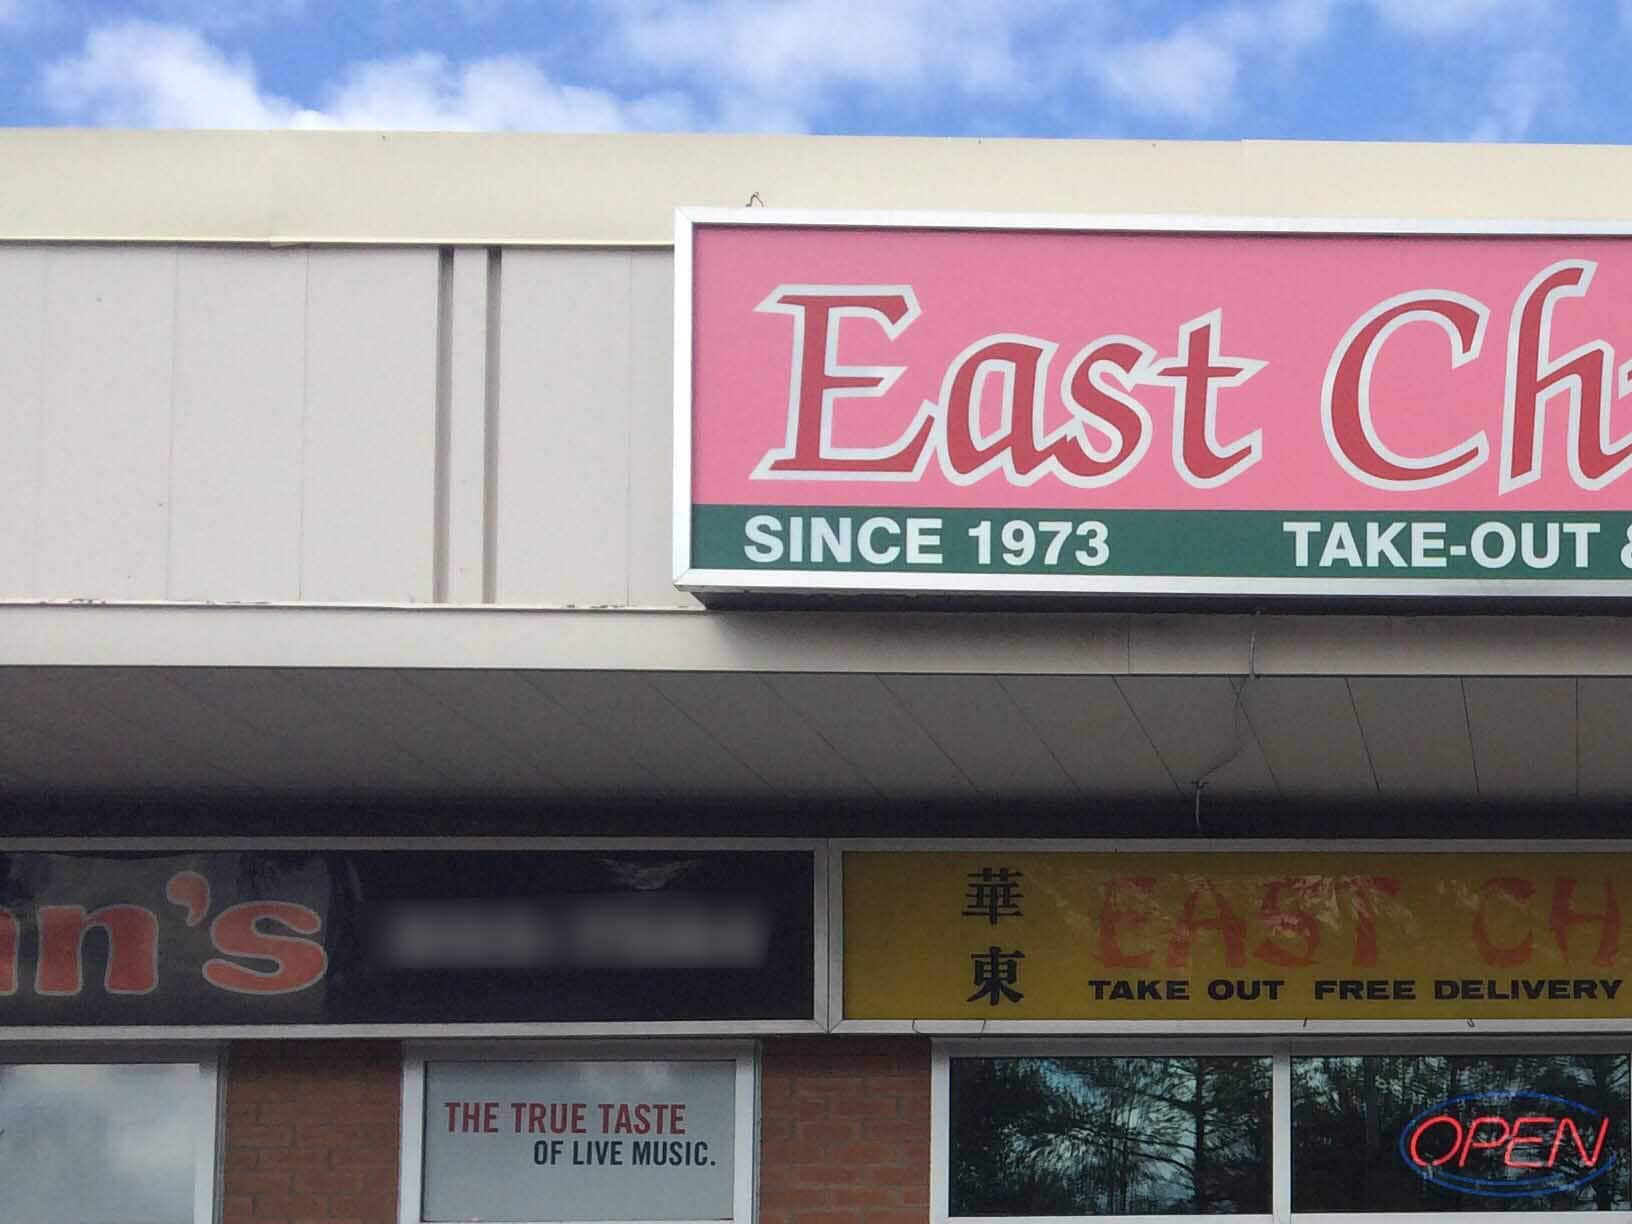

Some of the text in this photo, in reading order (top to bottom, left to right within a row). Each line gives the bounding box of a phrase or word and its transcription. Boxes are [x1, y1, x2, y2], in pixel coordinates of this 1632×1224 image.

[748, 284, 1269, 489] East
[743, 515, 1110, 567] SINCE 1973
[1283, 521, 1601, 569] TAKE-OUT
[0, 871, 328, 996] n's
[1094, 874, 1401, 969] EAST
[1088, 979, 1191, 1002] TAKE
[1207, 979, 1285, 1001] OUT
[1314, 979, 1416, 1001] FREE
[1434, 979, 1623, 1000] DELIVERY
[444, 1102, 686, 1135] THE TRUE TASTE
[1410, 1115, 1609, 1168] OPEN
[533, 1140, 716, 1166] OF LIVE MUSIC.
